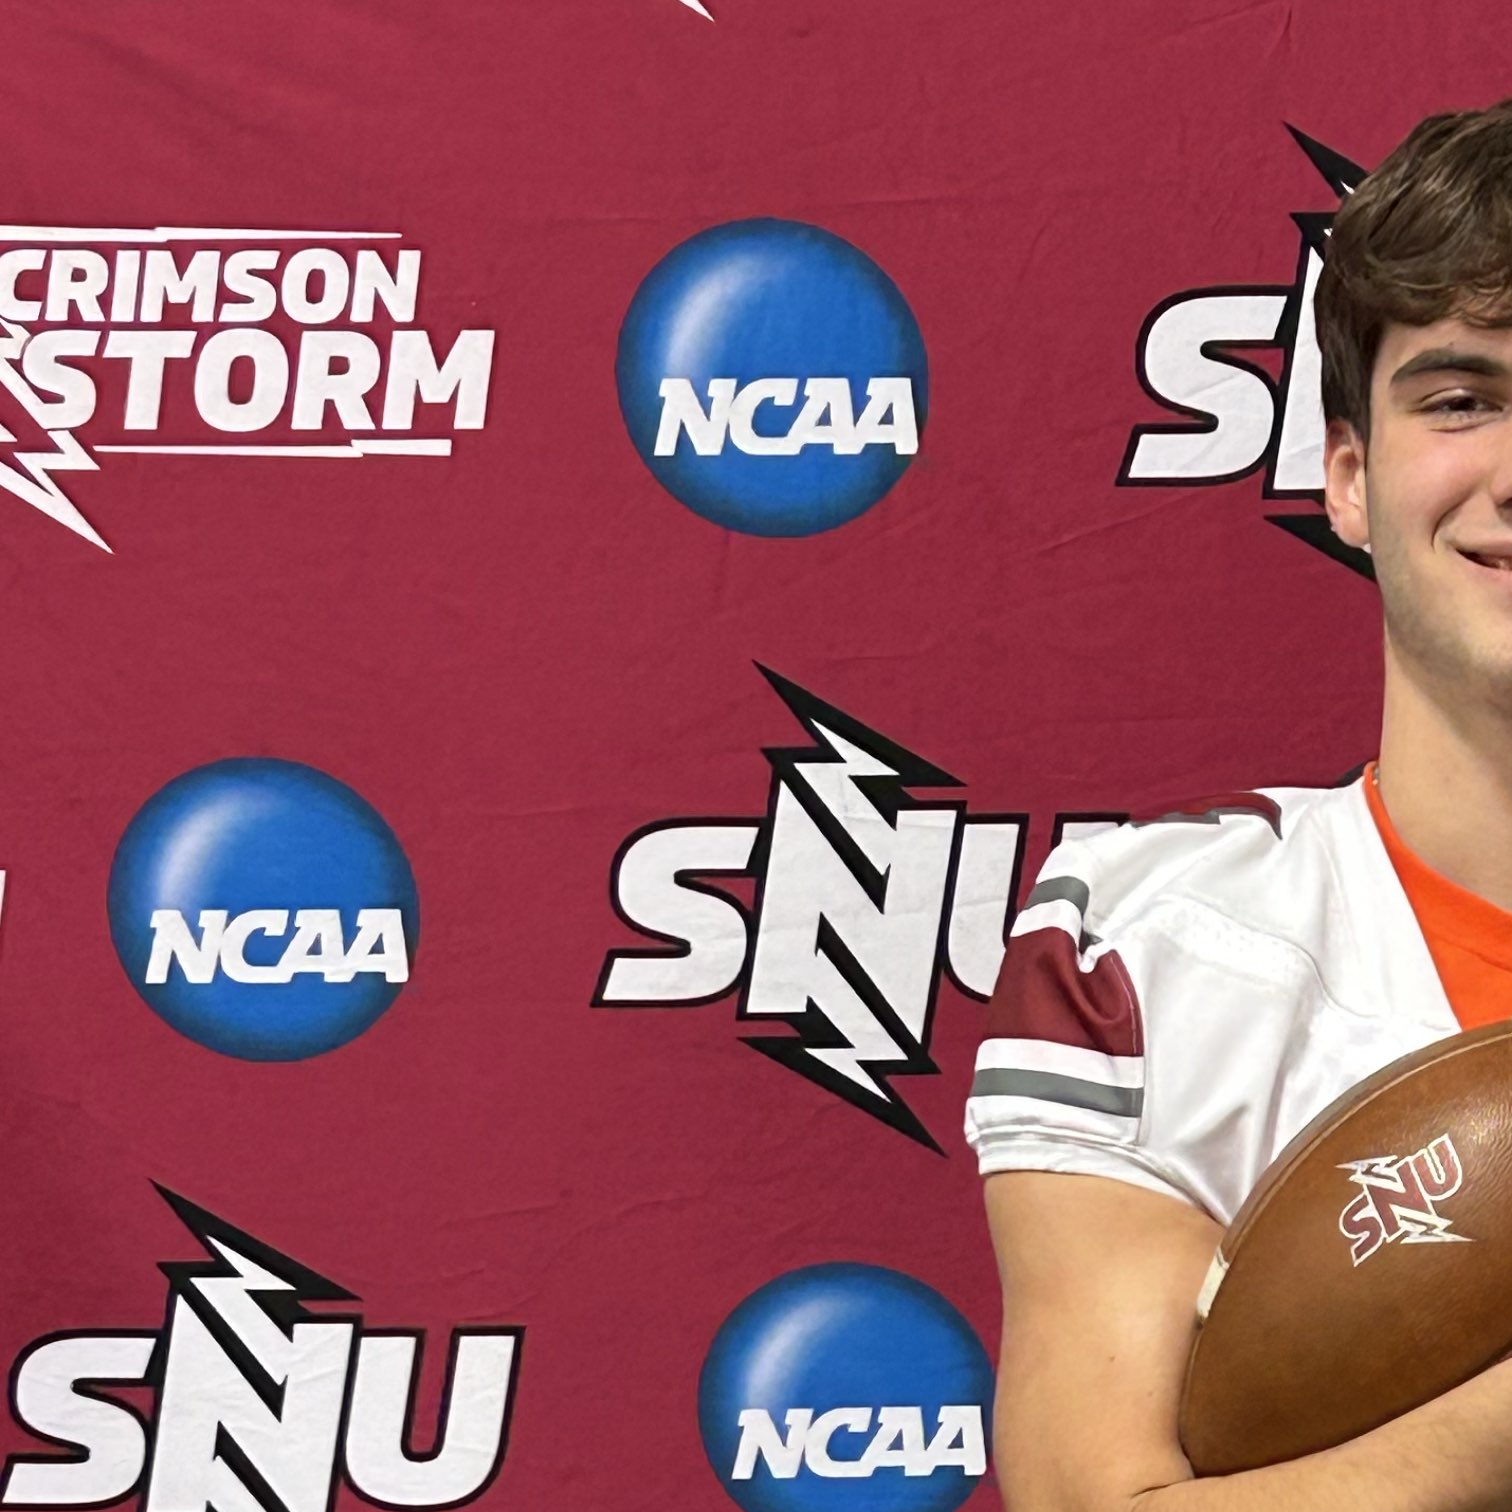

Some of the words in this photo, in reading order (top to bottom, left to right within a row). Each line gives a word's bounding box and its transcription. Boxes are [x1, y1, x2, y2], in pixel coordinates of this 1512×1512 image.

[0, 248, 421, 323] CRIMSON
[22, 329, 496, 432] STORM
[653, 377, 919, 457] NCAA
[145, 908, 410, 985] NCAA
[1338, 1133, 1470, 1267] SNU
[730, 1404, 987, 1481] NCAA
